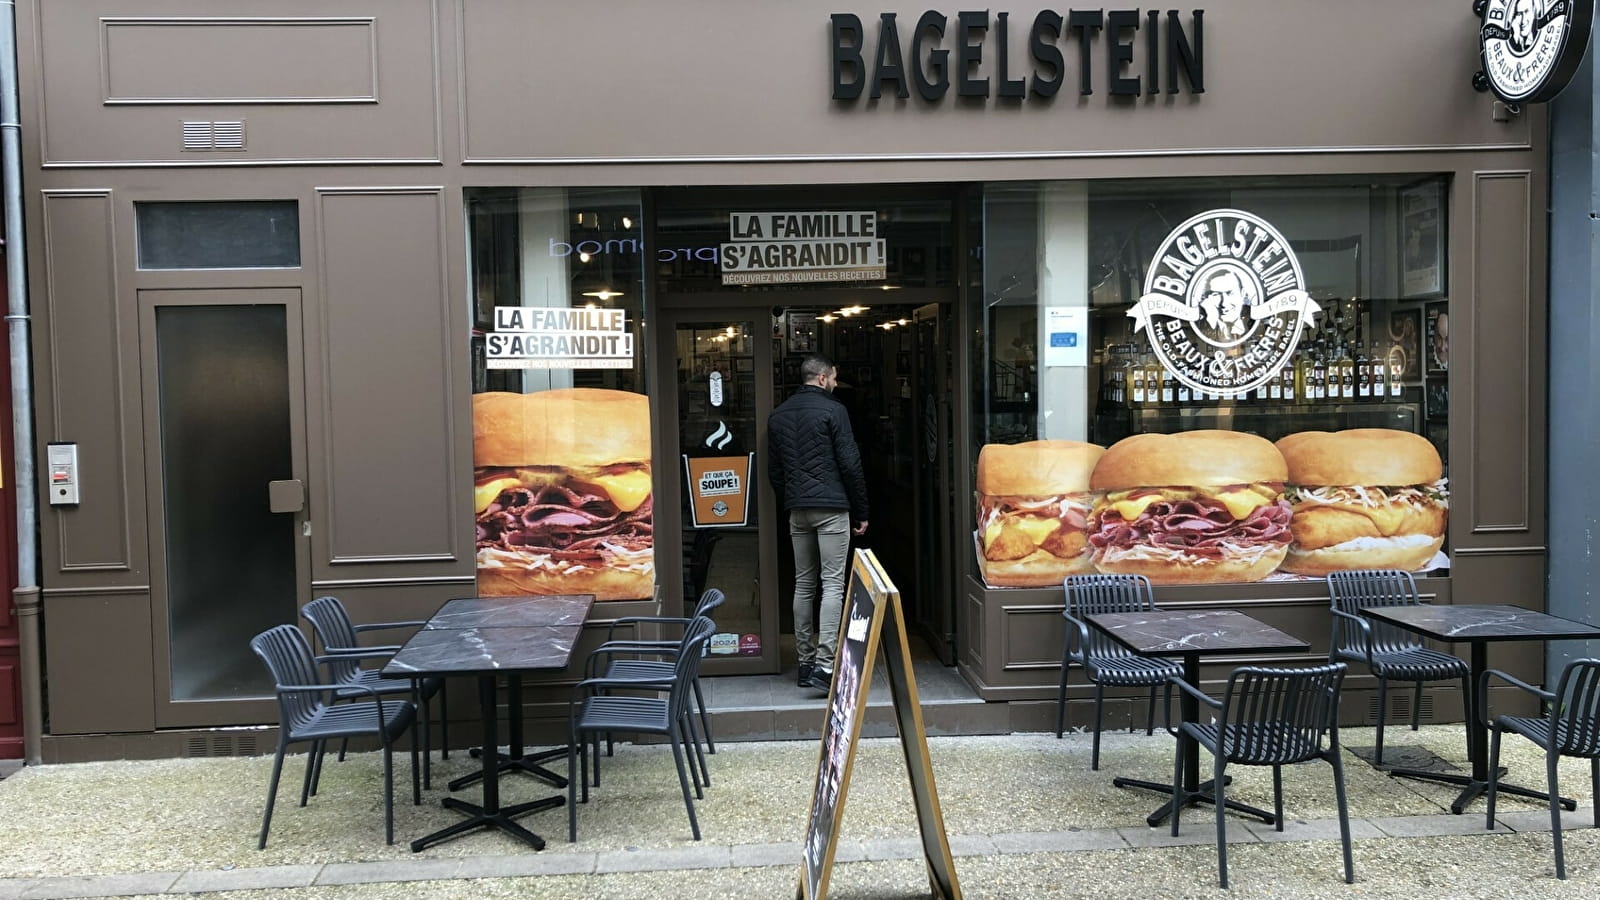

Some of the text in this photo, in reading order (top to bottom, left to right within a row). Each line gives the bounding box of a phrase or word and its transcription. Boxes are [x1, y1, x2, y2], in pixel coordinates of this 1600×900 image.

[1546, 2, 1564, 21] 1789
[830, 8, 1206, 100] BAGELSTEIN
[1493, 41, 1513, 80] BEAUX
[1513, 62, 1525, 83] &
[733, 214, 874, 238] LA FAMILLE
[1153, 218, 1297, 296] BAGELSTEIN
[723, 272, 771, 284] DÉCOUVREZ
[773, 272, 790, 282] NOS
[792, 270, 838, 281] NOUVELLES
[840, 269, 880, 280] RECETTES
[497, 309, 623, 332] LA FAMILLE
[1154, 321, 1166, 341] THE
[1278, 318, 1296, 350] BAGEL
[1166, 319, 1210, 368] BEAUX
[1208, 350, 1234, 378] &
